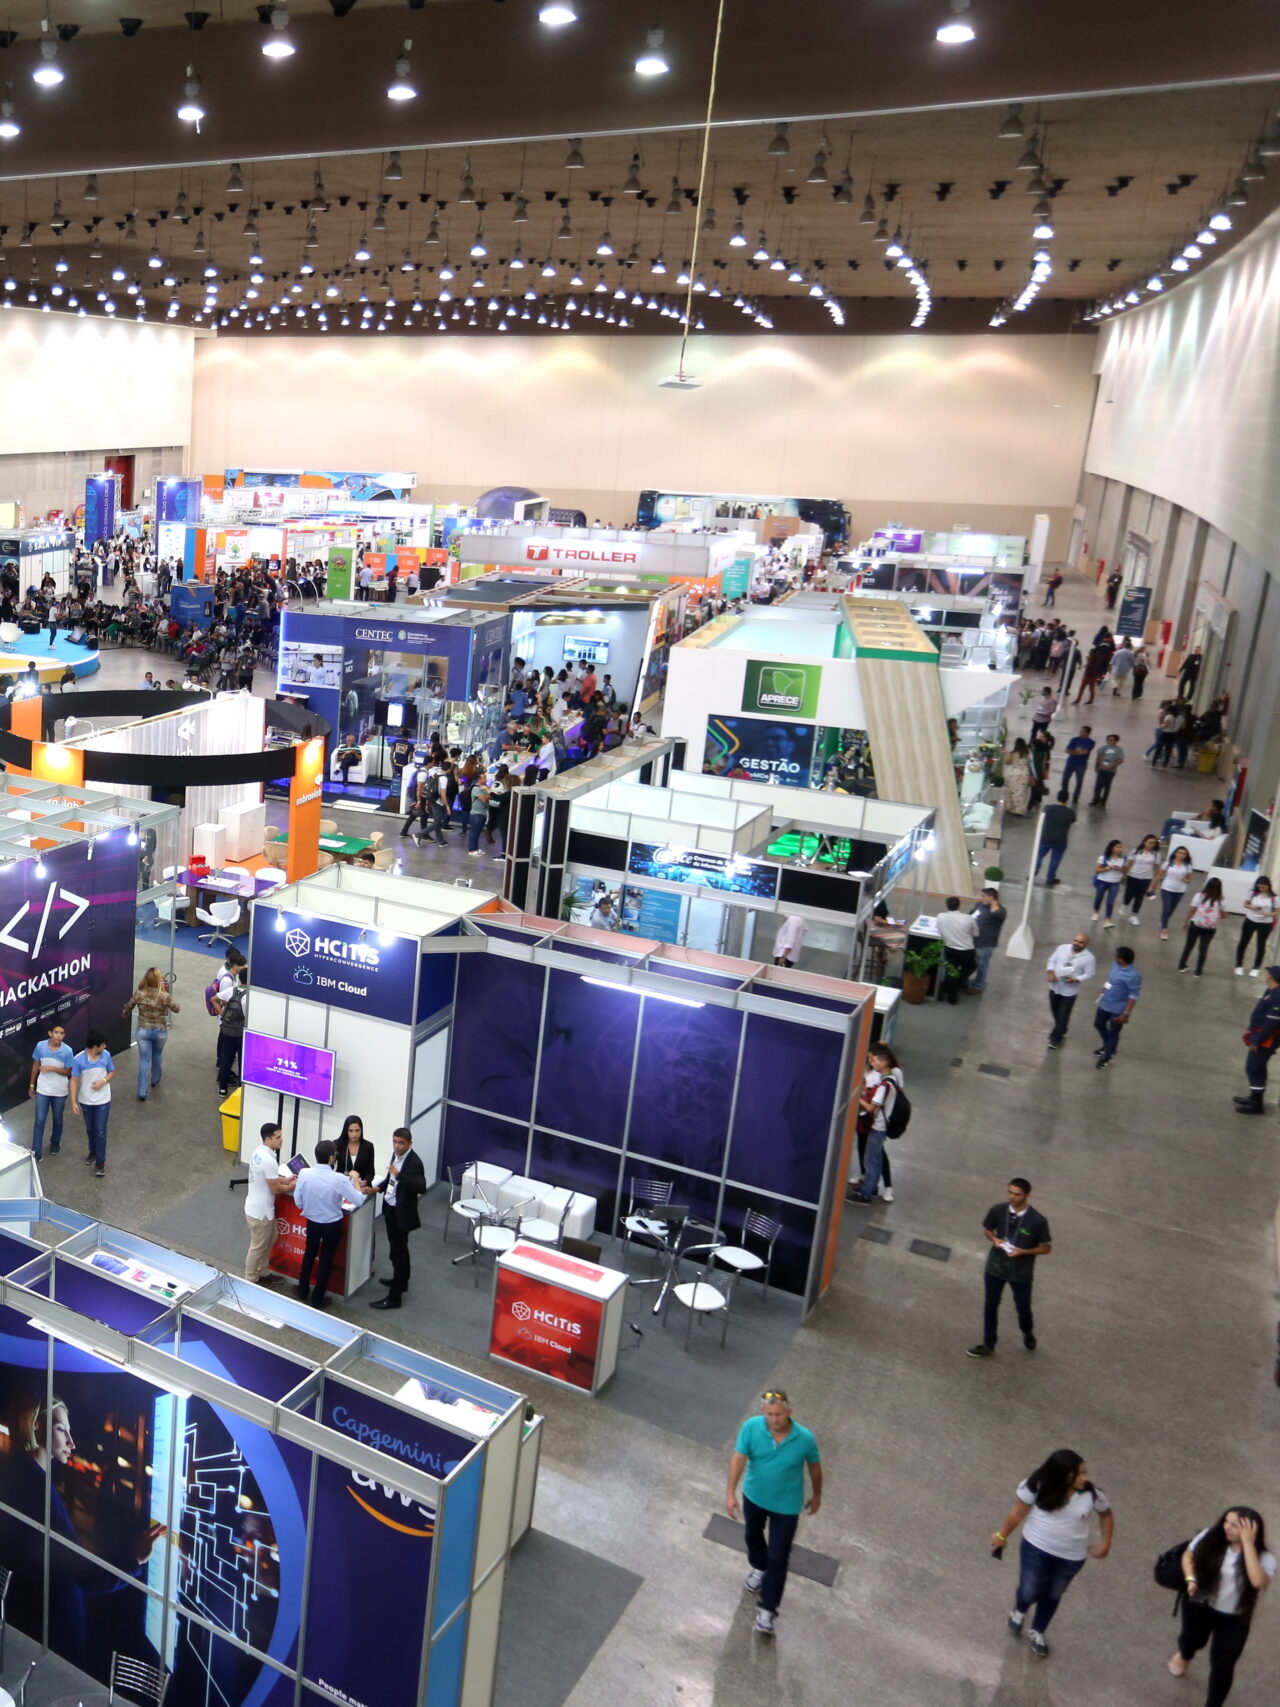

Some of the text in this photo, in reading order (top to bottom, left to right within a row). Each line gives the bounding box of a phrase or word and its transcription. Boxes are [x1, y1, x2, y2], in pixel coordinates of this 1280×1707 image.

[34, 540, 62, 551] SALA VIP
[552, 548, 637, 563] TROLLER
[355, 628, 393, 640] CENTEC
[761, 694, 799, 705] APRECE
[739, 757, 800, 773] GESTÃO
[314, 953, 379, 972] HYPERCONVERGENCE
[316, 975, 367, 997] IBM Cloud
[277, 1057, 298, 1070] 71%
[534, 1334, 572, 1354] IBM Cloud
[332, 1406, 443, 1473] Capgemini
[318, 1677, 348, 1701] People
